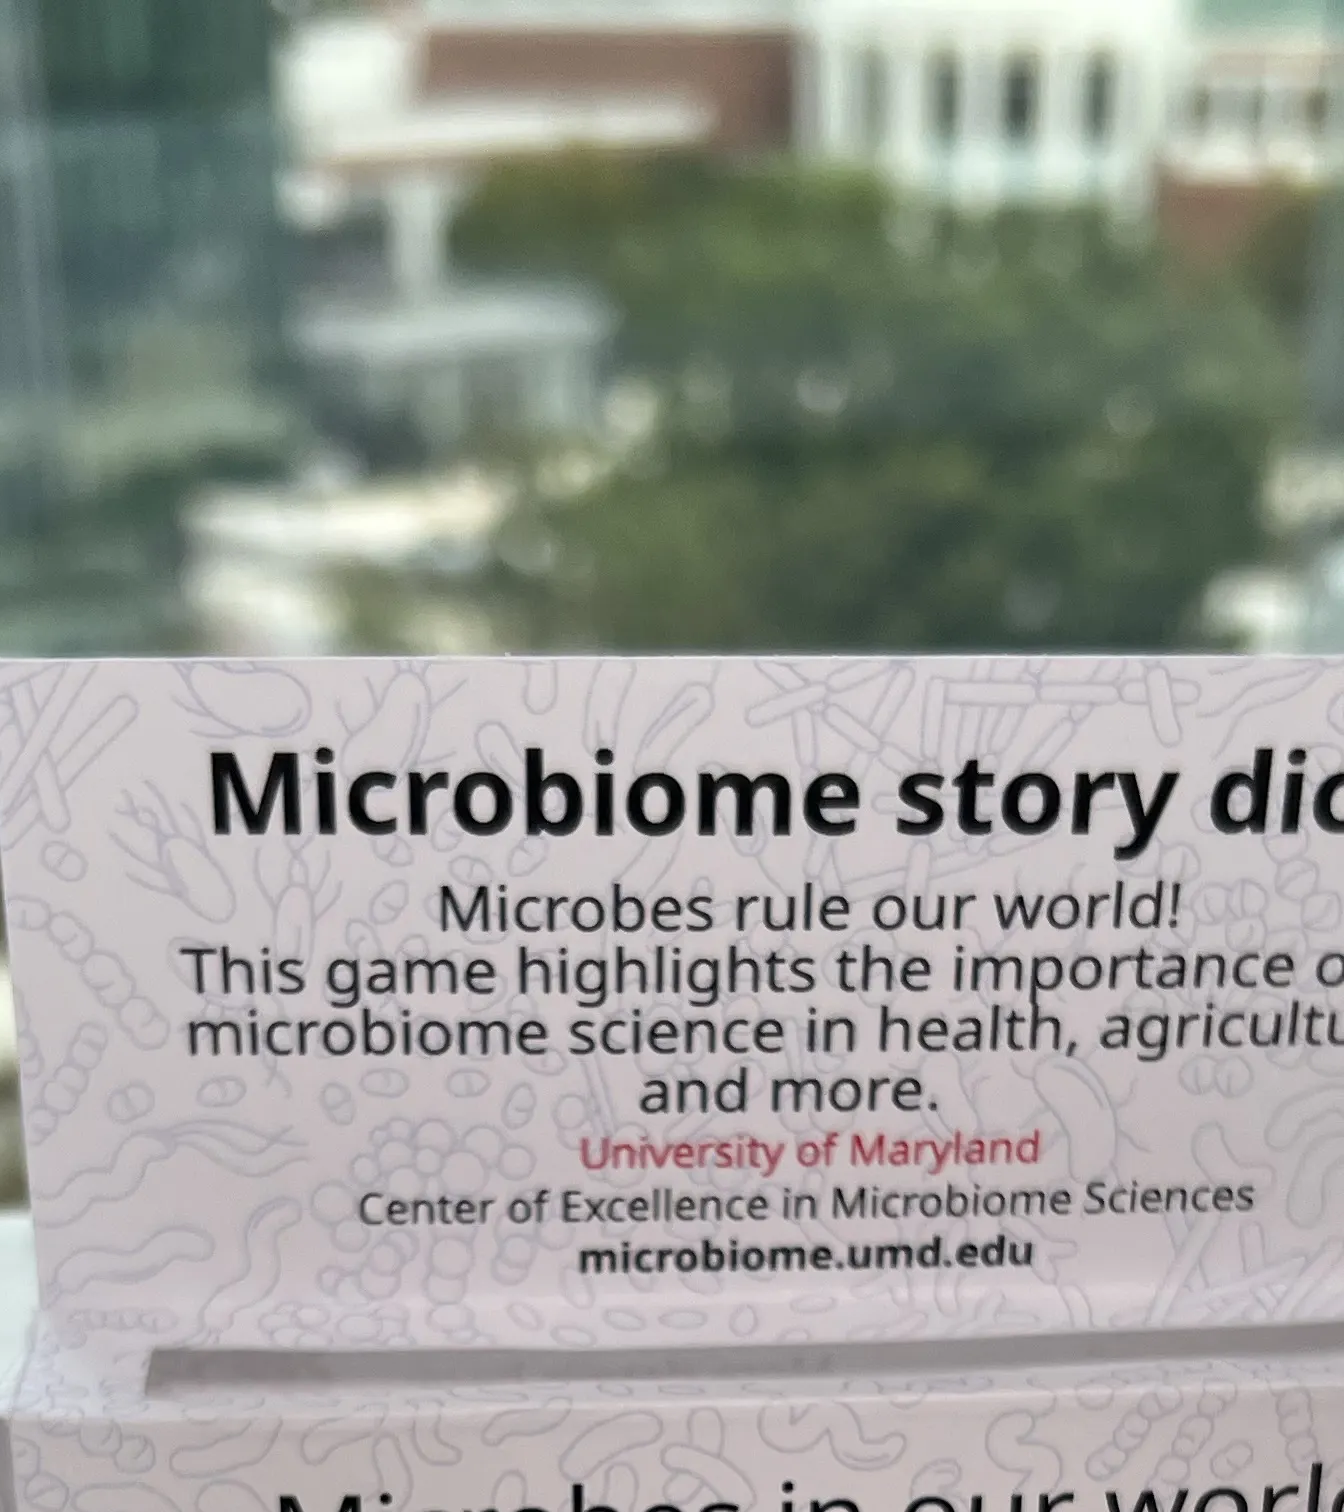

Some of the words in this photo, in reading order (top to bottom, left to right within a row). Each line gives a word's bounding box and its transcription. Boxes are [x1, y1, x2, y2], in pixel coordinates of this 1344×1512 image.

[210, 746, 860, 837] Microbiome
[897, 759, 1180, 860] story
[440, 883, 713, 933] Microbes
[737, 882, 850, 932] rule
[873, 894, 977, 931] our
[993, 879, 1181, 930] world!
[179, 945, 305, 995] This
[326, 958, 496, 1009] game
[519, 945, 815, 1008] highlights
[836, 944, 931, 993] the
[954, 945, 1295, 1005] importance
[188, 1007, 548, 1056] microbiome
[570, 1008, 784, 1055] science
[807, 1007, 856, 1053] in
[879, 1004, 1077, 1057] health,
[639, 1066, 747, 1114] and
[772, 1077, 938, 1113] more.
[580, 1136, 785, 1178] University
[796, 1131, 840, 1168] of
[851, 1129, 1040, 1175] Maryland
[358, 1192, 495, 1226] Center
[507, 1188, 550, 1224] of
[561, 1188, 769, 1223] Excellence
[783, 1187, 817, 1219] in
[832, 1183, 1072, 1219] Microbiome
[1084, 1180, 1254, 1214] Sciences
[579, 1234, 1033, 1274] microbiome.umd.edu
